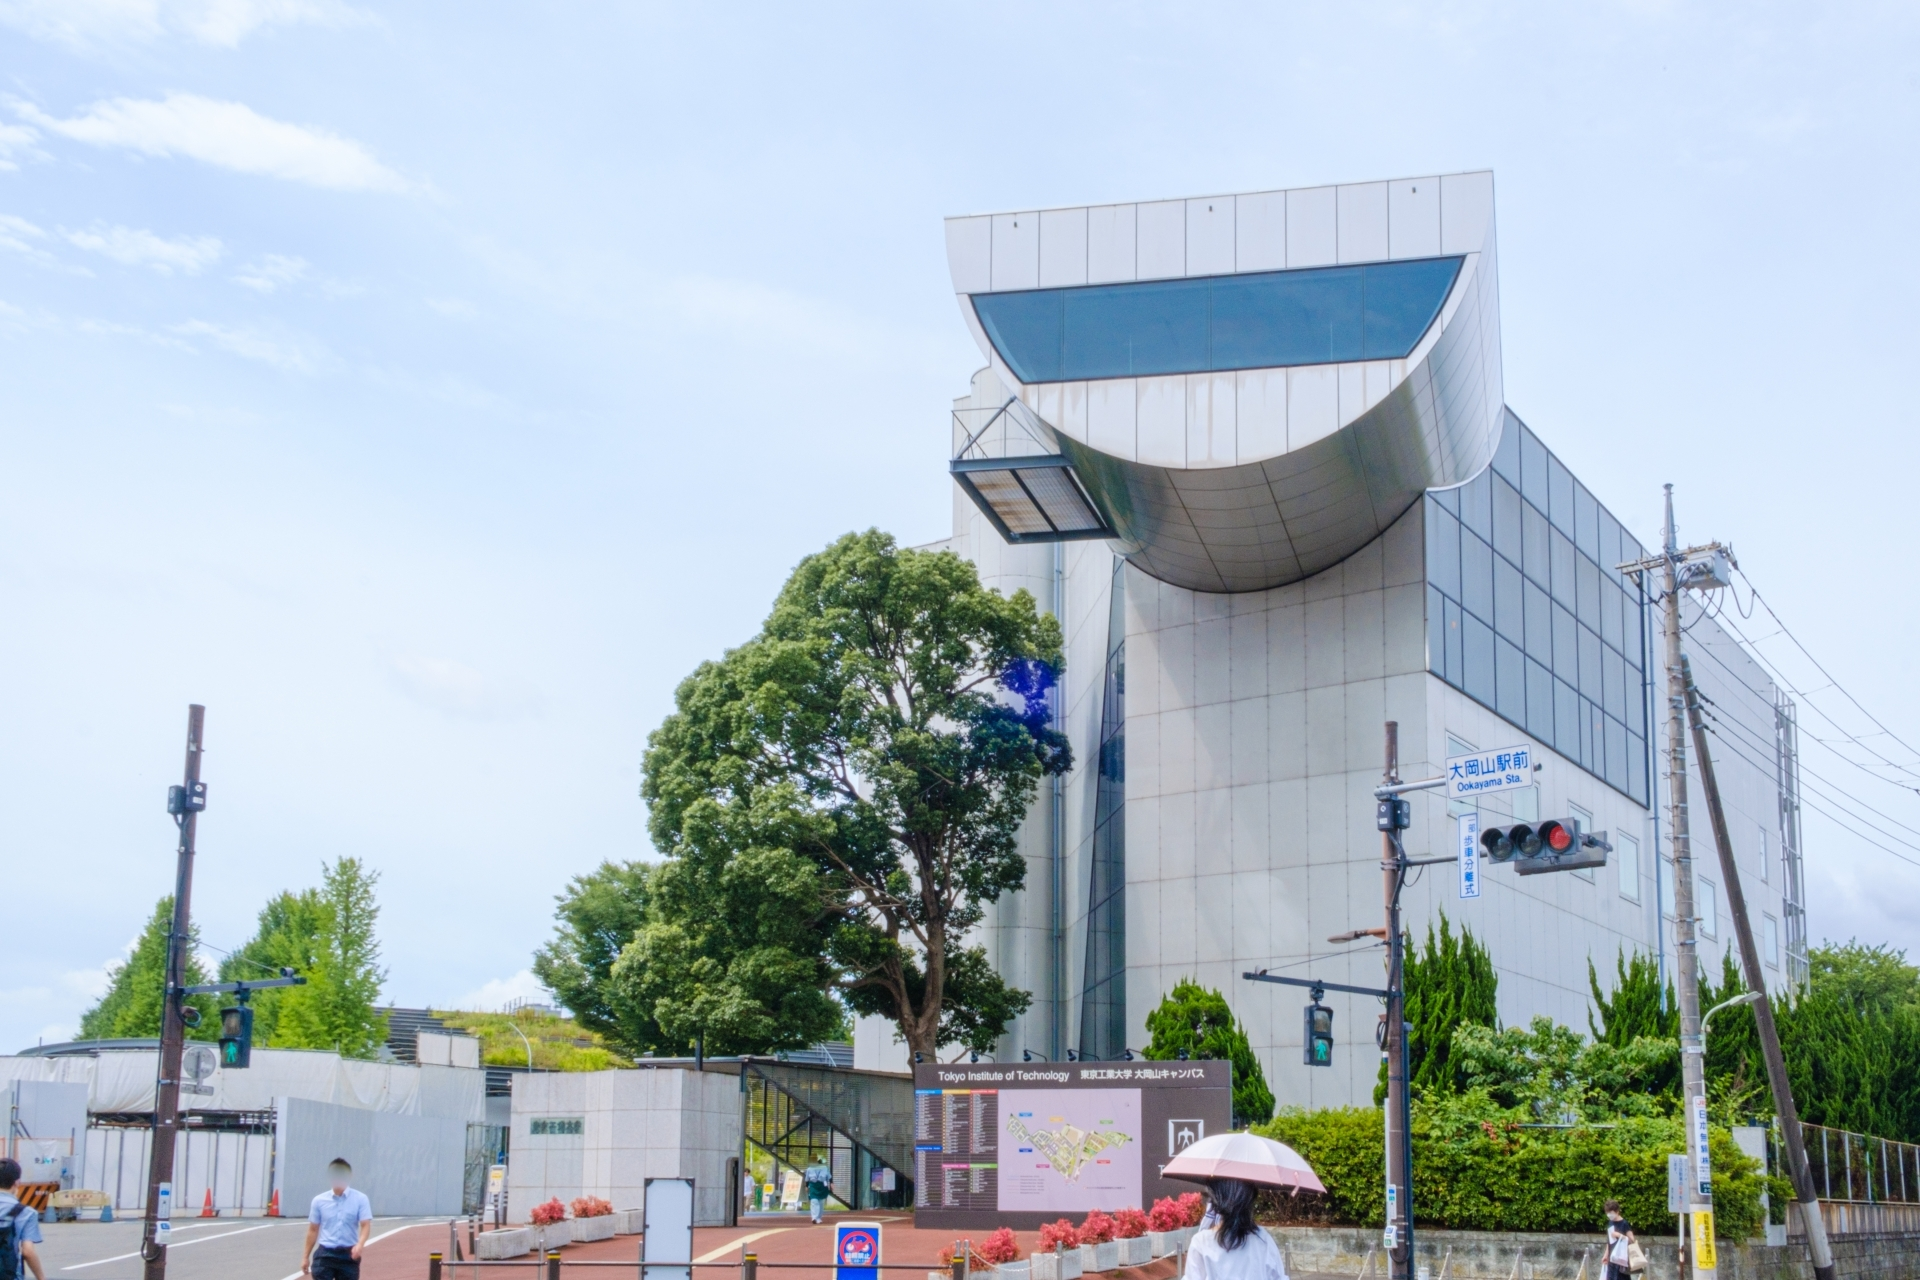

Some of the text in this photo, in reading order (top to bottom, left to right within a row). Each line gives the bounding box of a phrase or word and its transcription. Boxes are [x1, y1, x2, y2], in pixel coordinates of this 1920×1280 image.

[1449, 750, 1528, 780] 大岡山駅前
[1457, 774, 1522, 792] Ookayama Sta.
[938, 1070, 1070, 1083] Tokyo Institute of Technology
[1080, 1069, 1205, 1080] 東京工業大学 大岡山キャンパス
